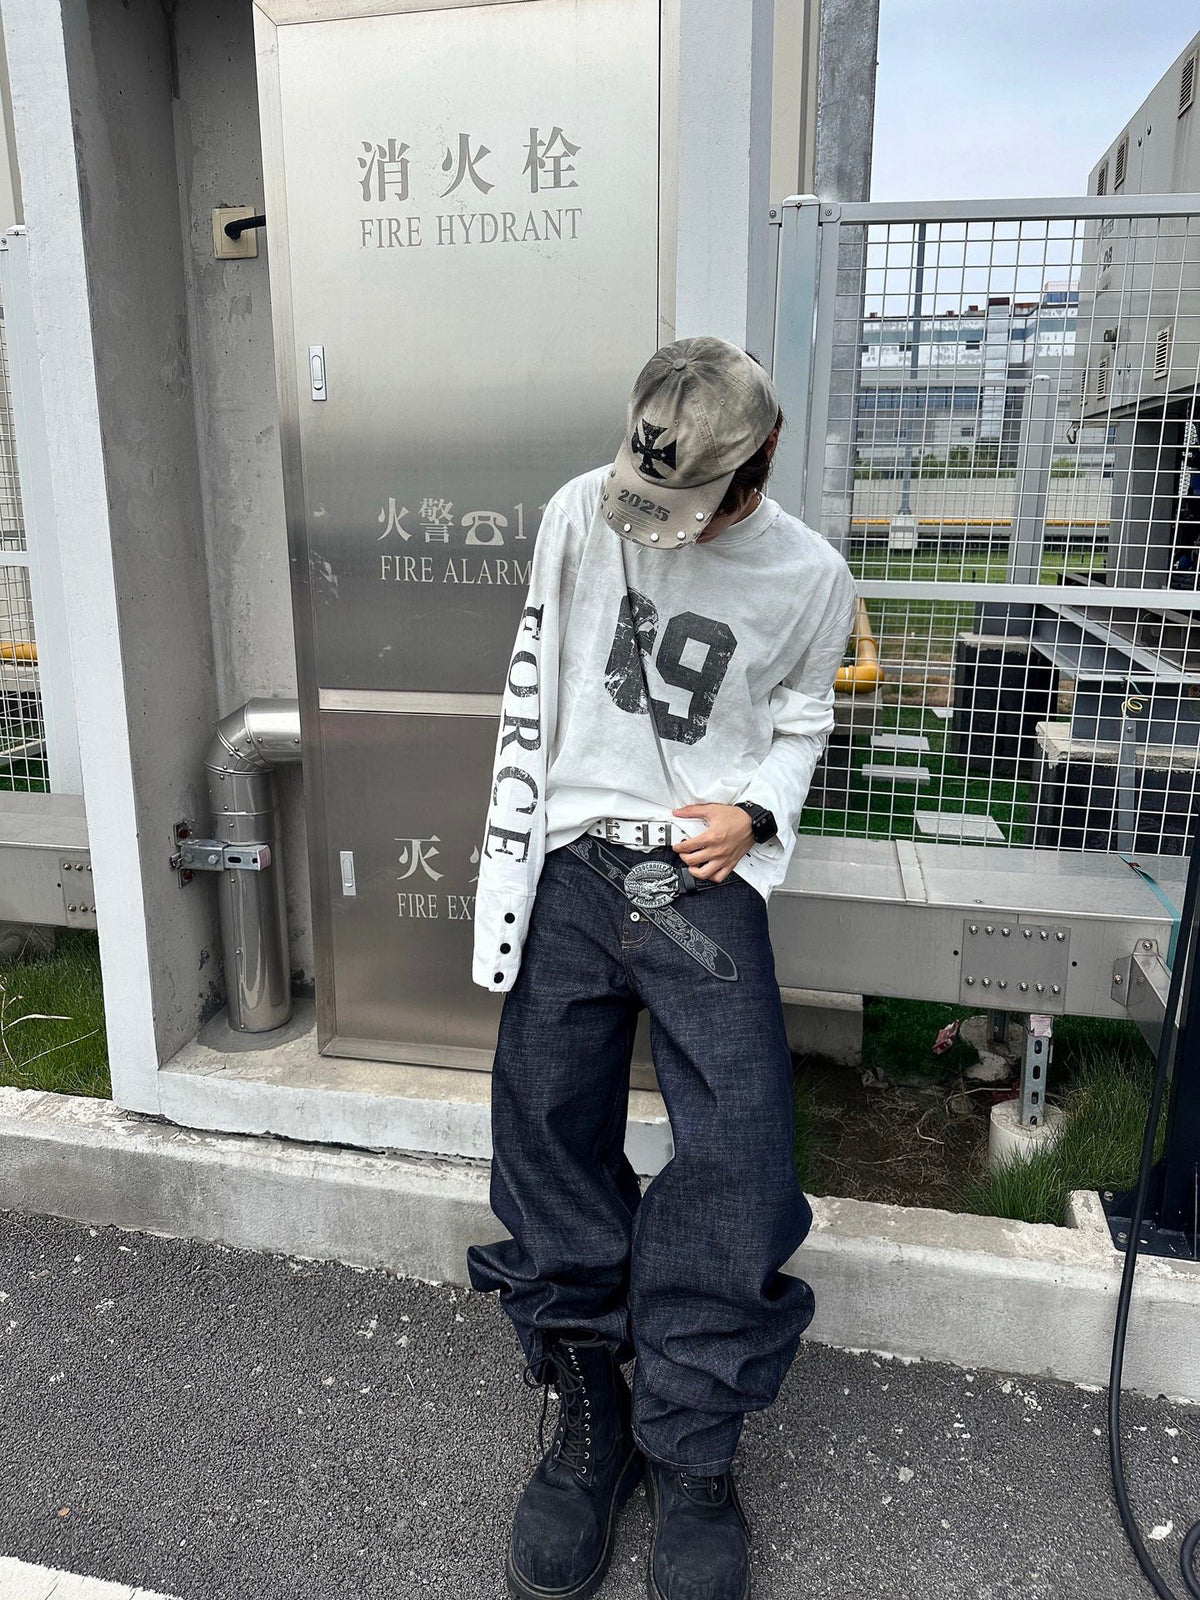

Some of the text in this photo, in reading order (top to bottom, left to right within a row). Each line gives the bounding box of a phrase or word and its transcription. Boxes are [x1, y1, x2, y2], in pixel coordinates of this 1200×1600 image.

[357, 126, 582, 202] 消火栓
[360, 208, 583, 249] FIRE HYDRANT
[617, 489, 671, 521] 2025
[380, 555, 532, 586] FIRE ALARM
[484, 603, 544, 863] FORCE
[394, 835, 480, 884] 灭
[397, 893, 476, 921] FIRE EX
